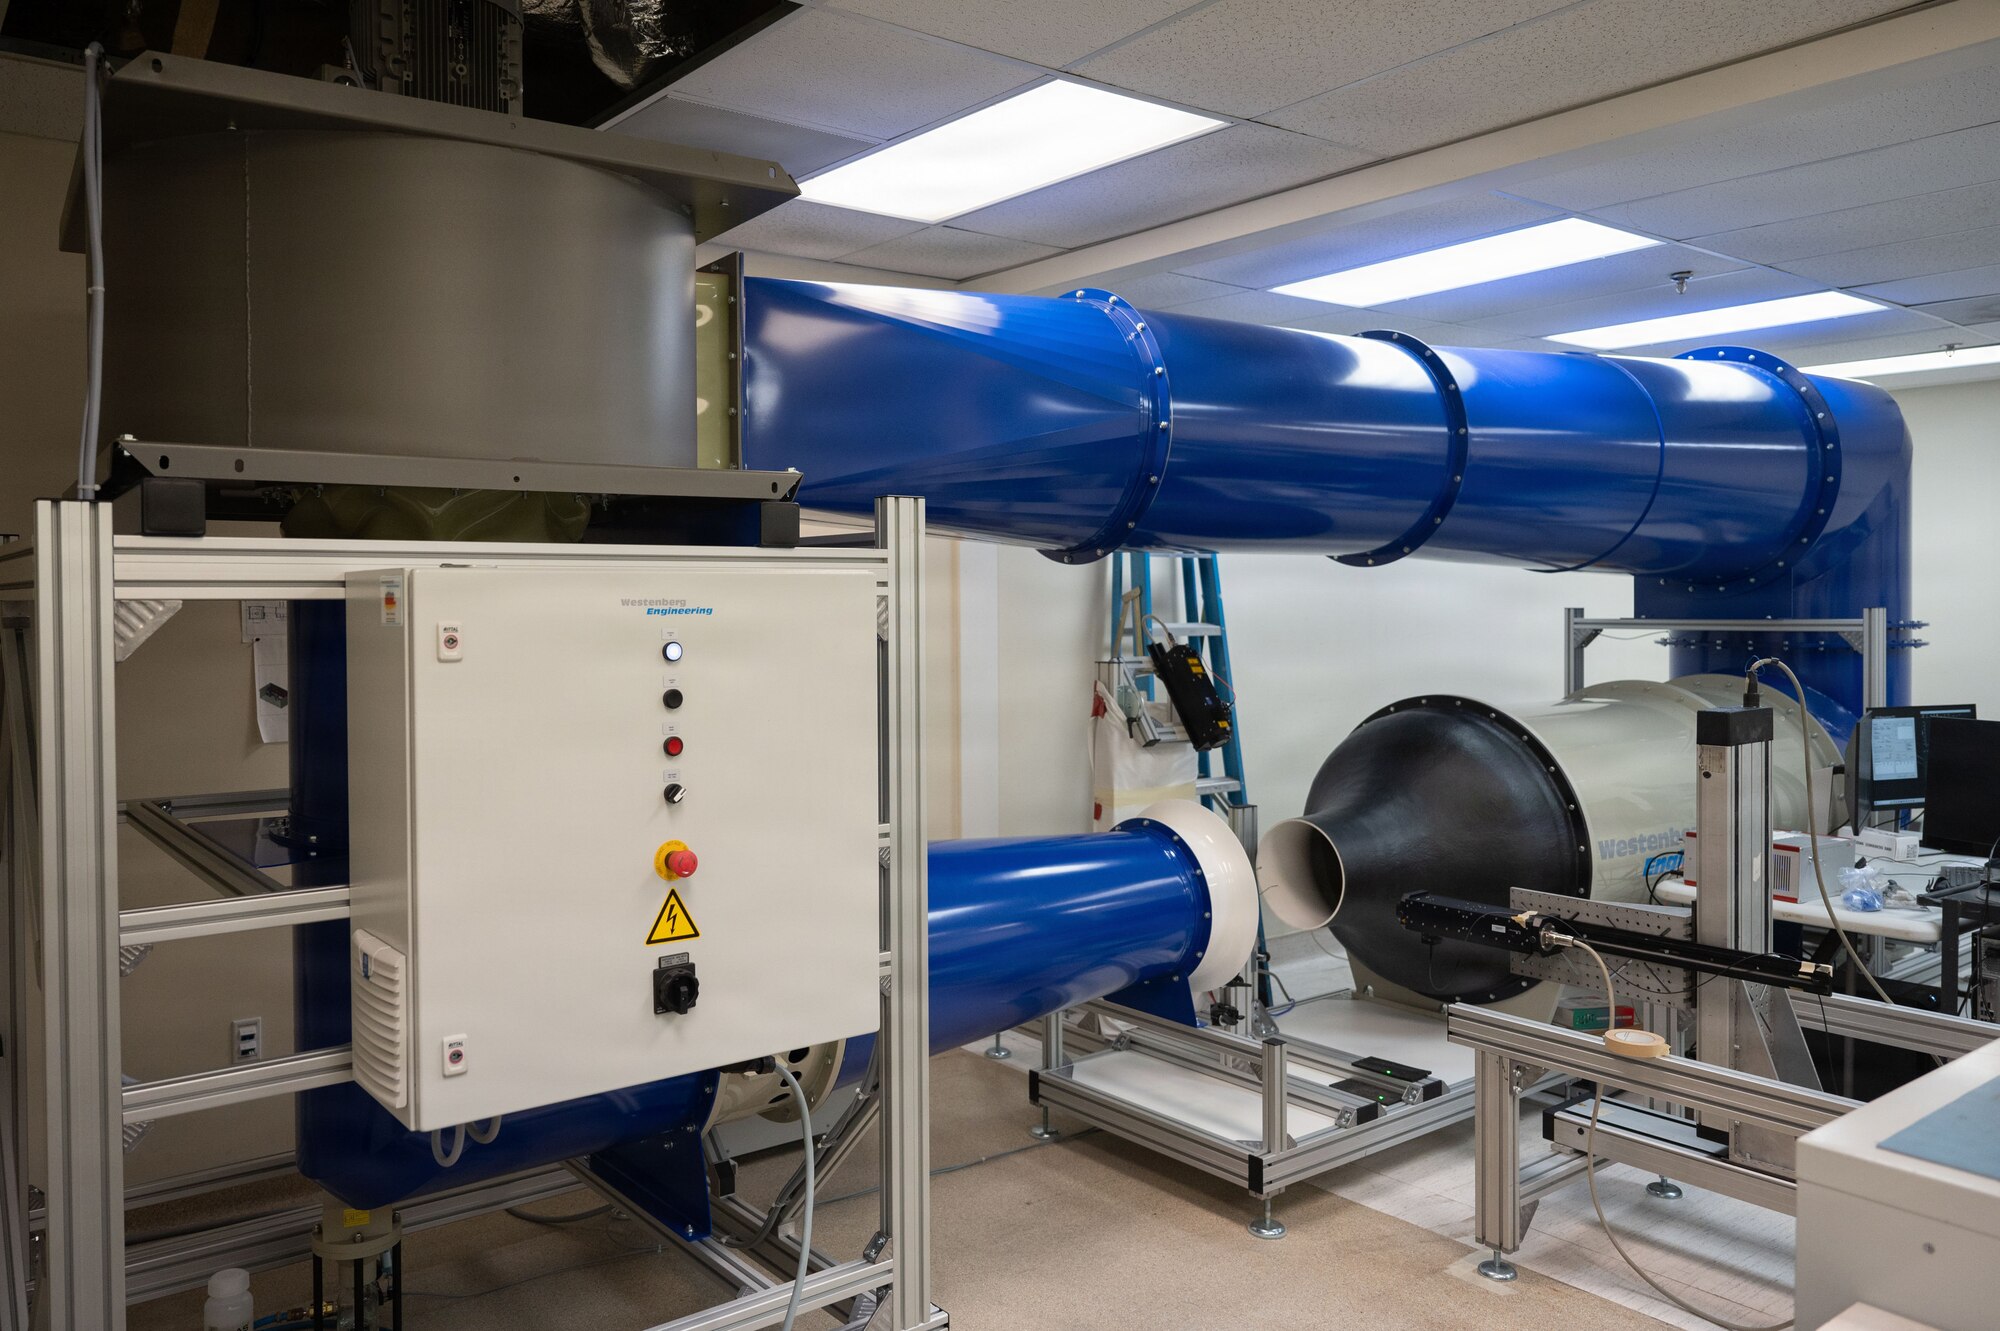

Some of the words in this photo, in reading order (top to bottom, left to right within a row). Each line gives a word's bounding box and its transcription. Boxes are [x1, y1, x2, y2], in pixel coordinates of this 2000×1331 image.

[621, 598, 687, 608] Westenberg
[646, 606, 713, 616] Engineering
[1598, 827, 1697, 860] Westenb
